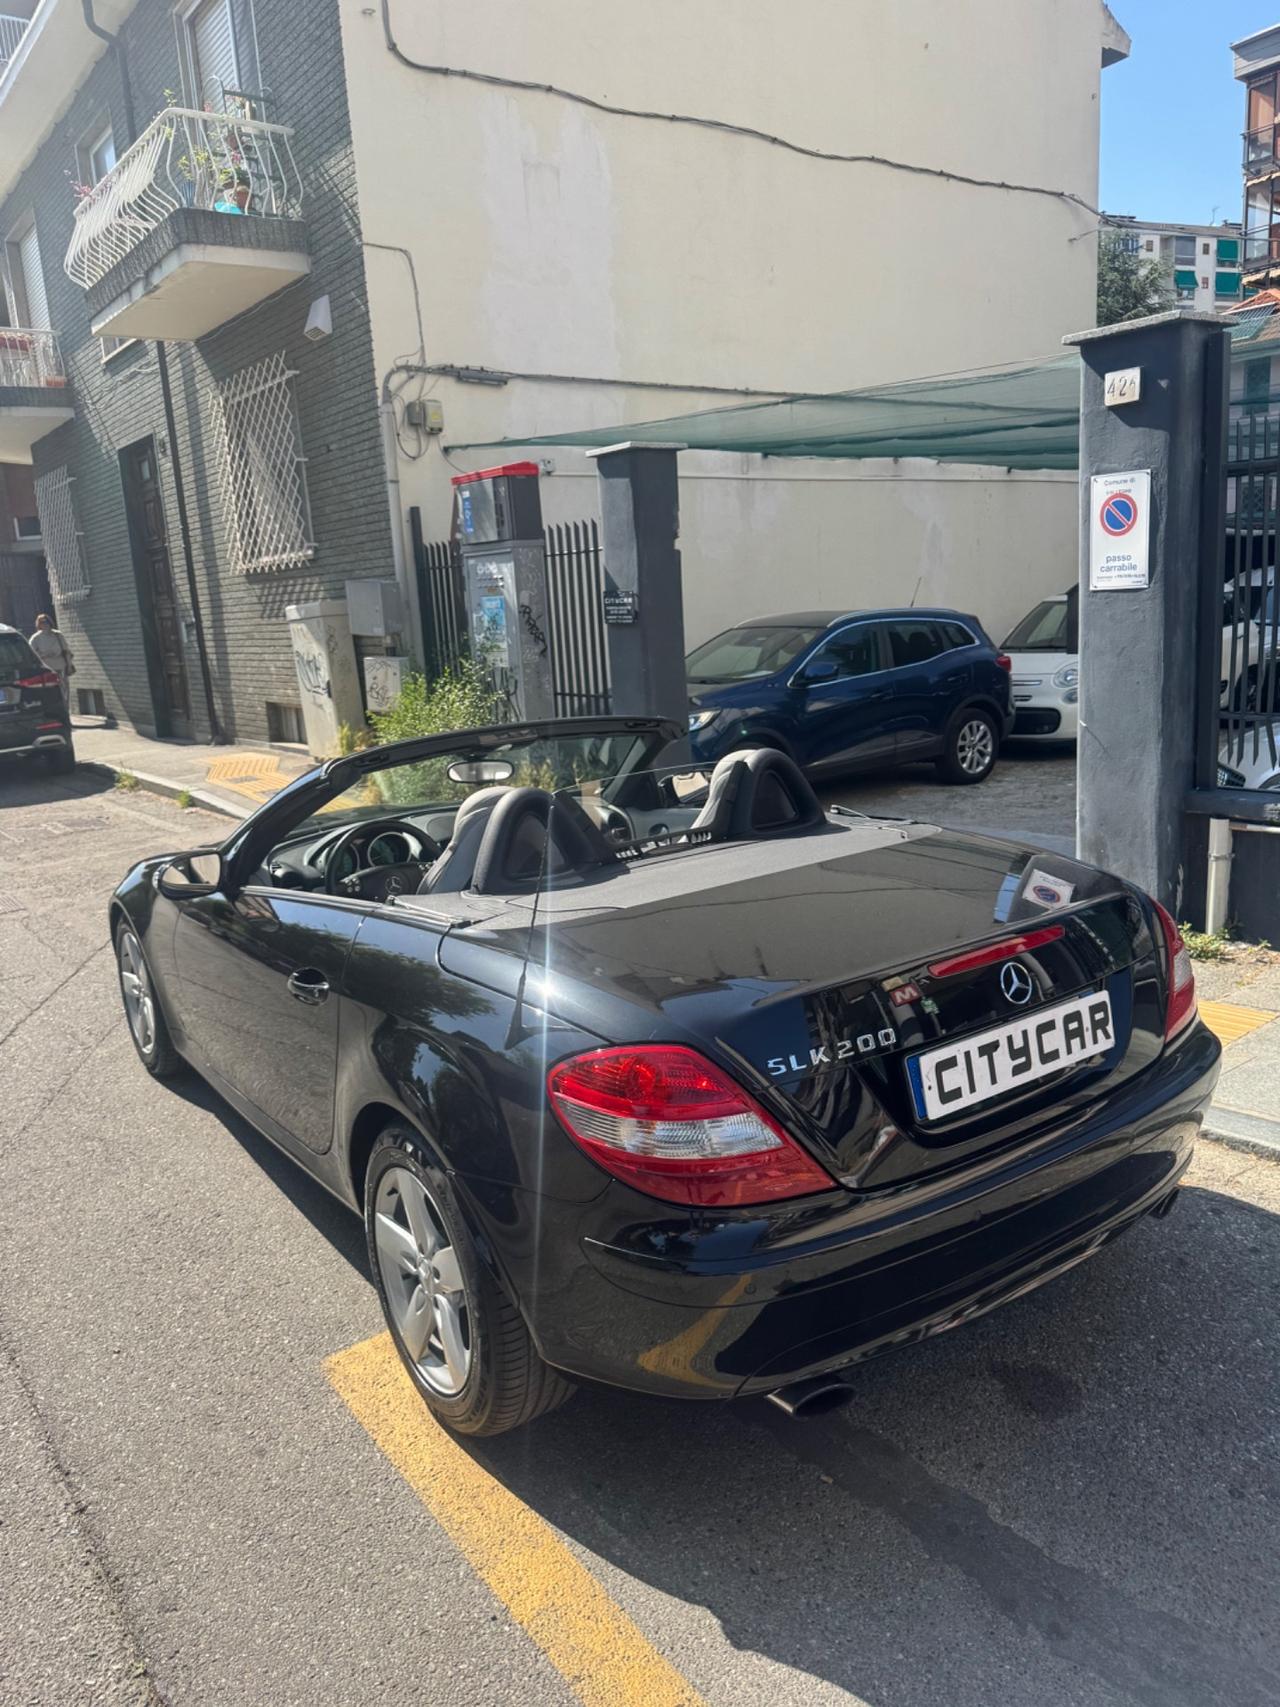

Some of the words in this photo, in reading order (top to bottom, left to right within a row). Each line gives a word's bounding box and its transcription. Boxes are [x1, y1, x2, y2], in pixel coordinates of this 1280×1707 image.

[1100, 563, 1138, 573] carrabile
[1106, 554, 1132, 564] passo
[767, 1044, 831, 1076] SLK
[837, 1027, 897, 1060] 200
[934, 1000, 1113, 1105] CITYCAR
